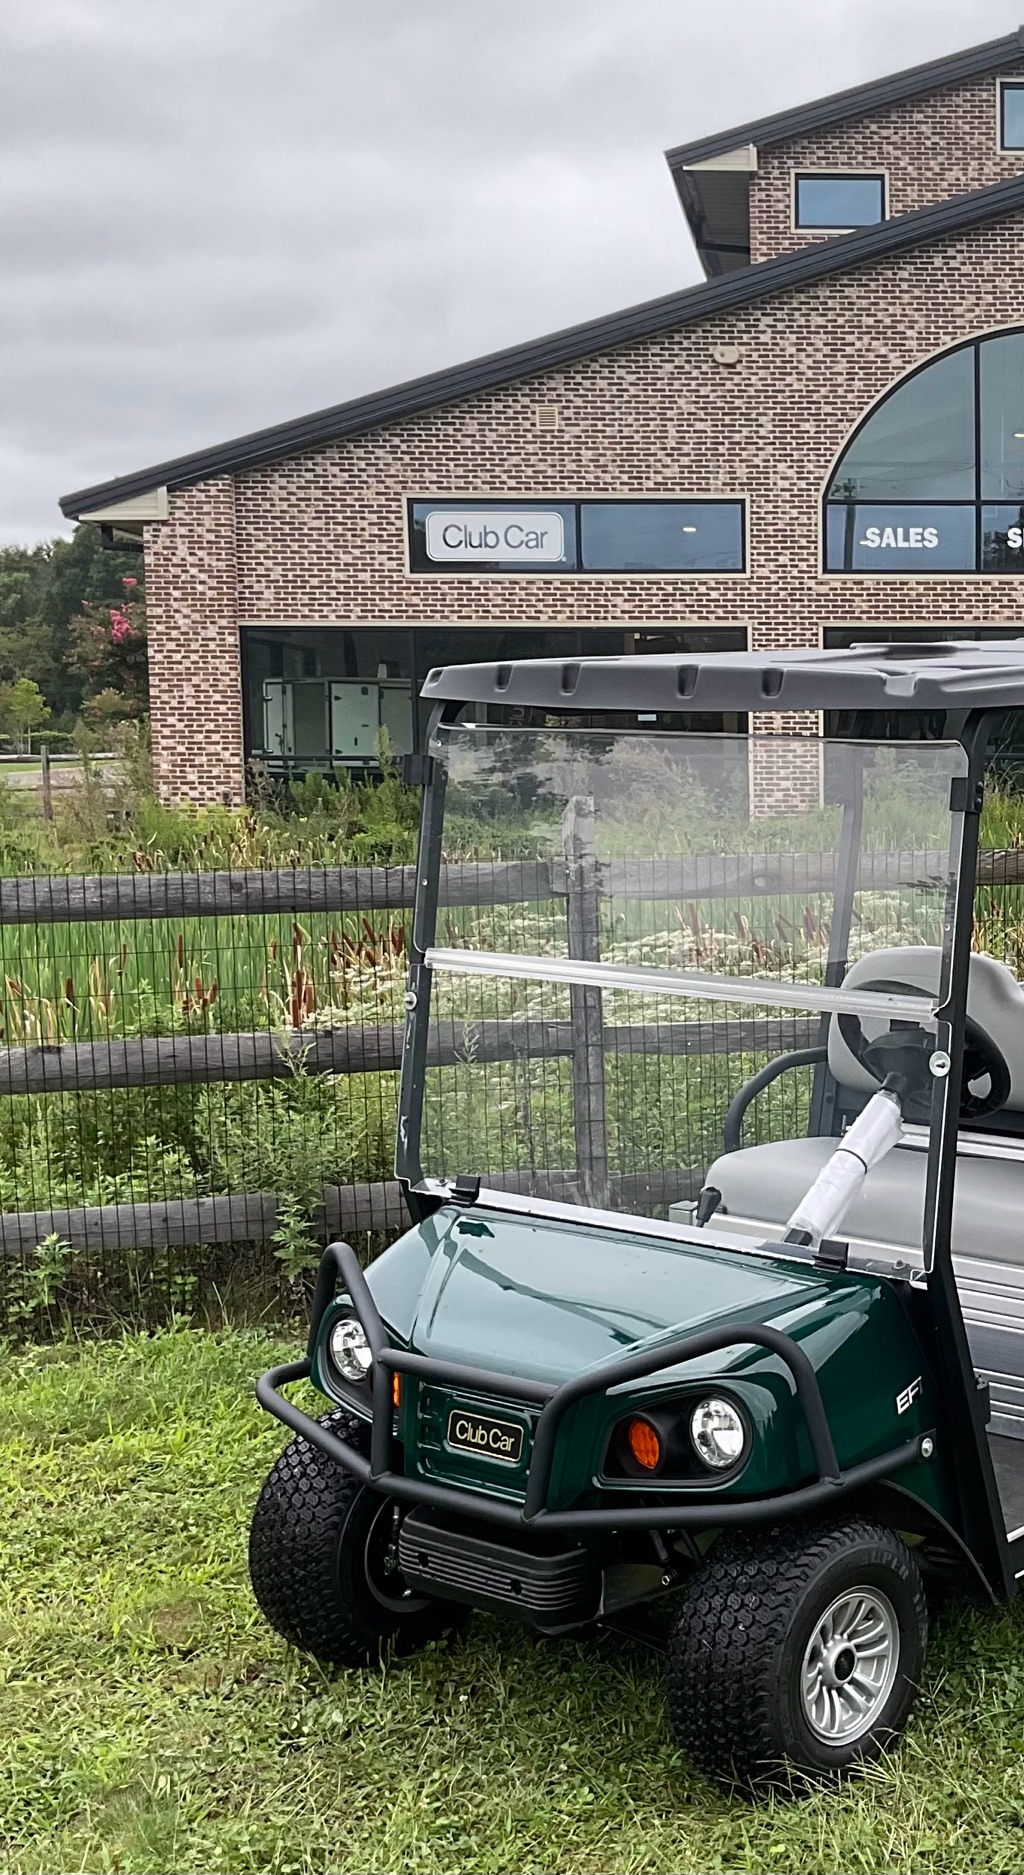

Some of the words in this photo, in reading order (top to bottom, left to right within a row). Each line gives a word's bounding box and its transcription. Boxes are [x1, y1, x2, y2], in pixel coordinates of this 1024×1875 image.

[442, 524, 500, 549] Club
[503, 524, 549, 549] Car
[866, 527, 939, 548] SALES
[455, 1420, 488, 1445] Club
[489, 1428, 515, 1452] Car
